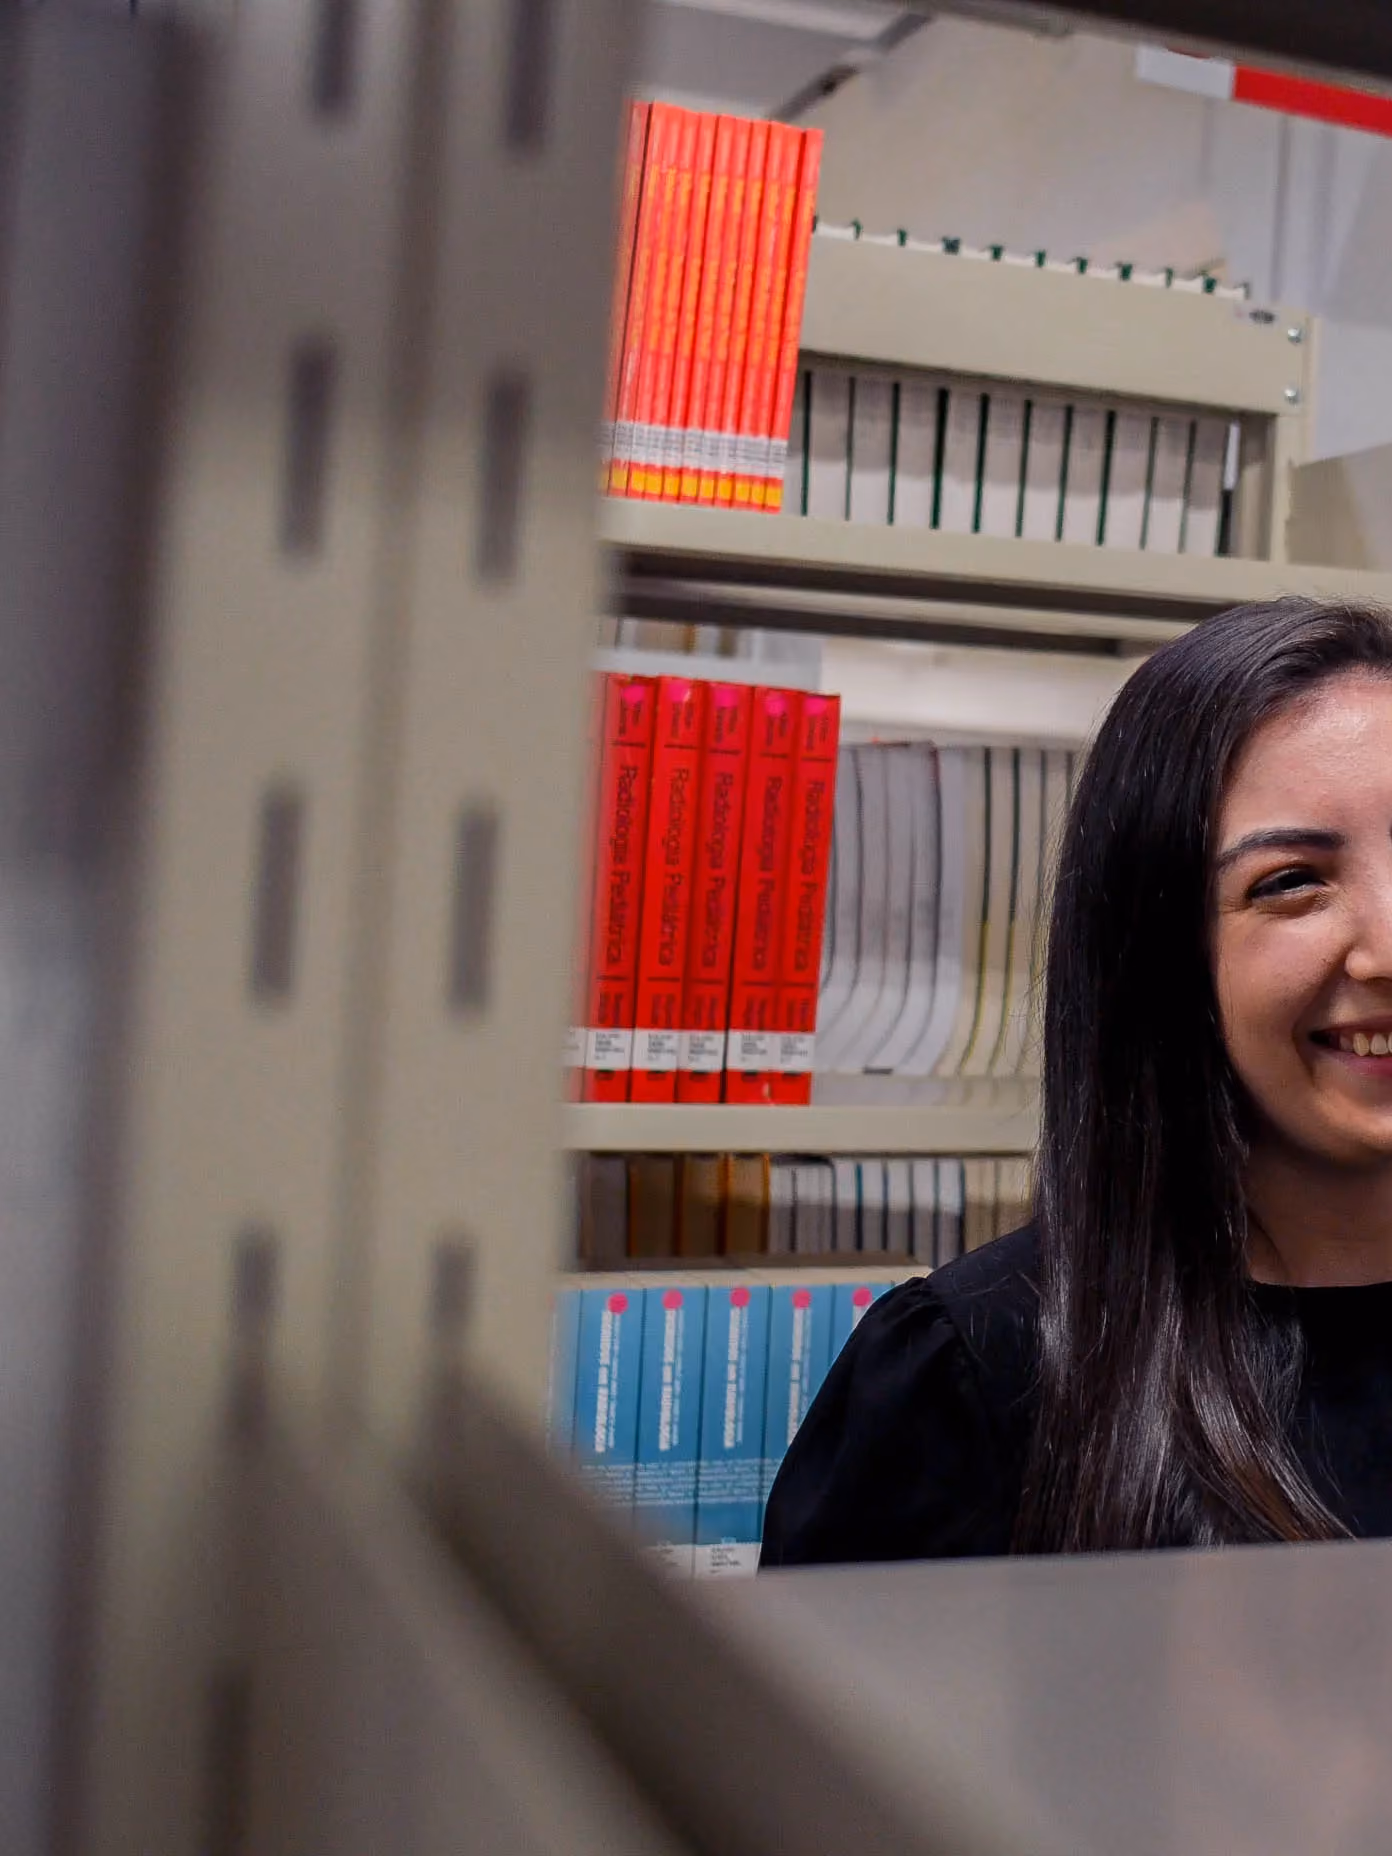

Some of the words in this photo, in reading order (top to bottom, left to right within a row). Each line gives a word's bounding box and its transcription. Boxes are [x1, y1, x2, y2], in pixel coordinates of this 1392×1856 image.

[610, 764, 638, 865] Radiologia
[662, 766, 691, 866] Radiologia
[706, 771, 734, 870] Radiologia
[757, 775, 783, 872] Radiologia
[801, 780, 826, 876] Radiologia
